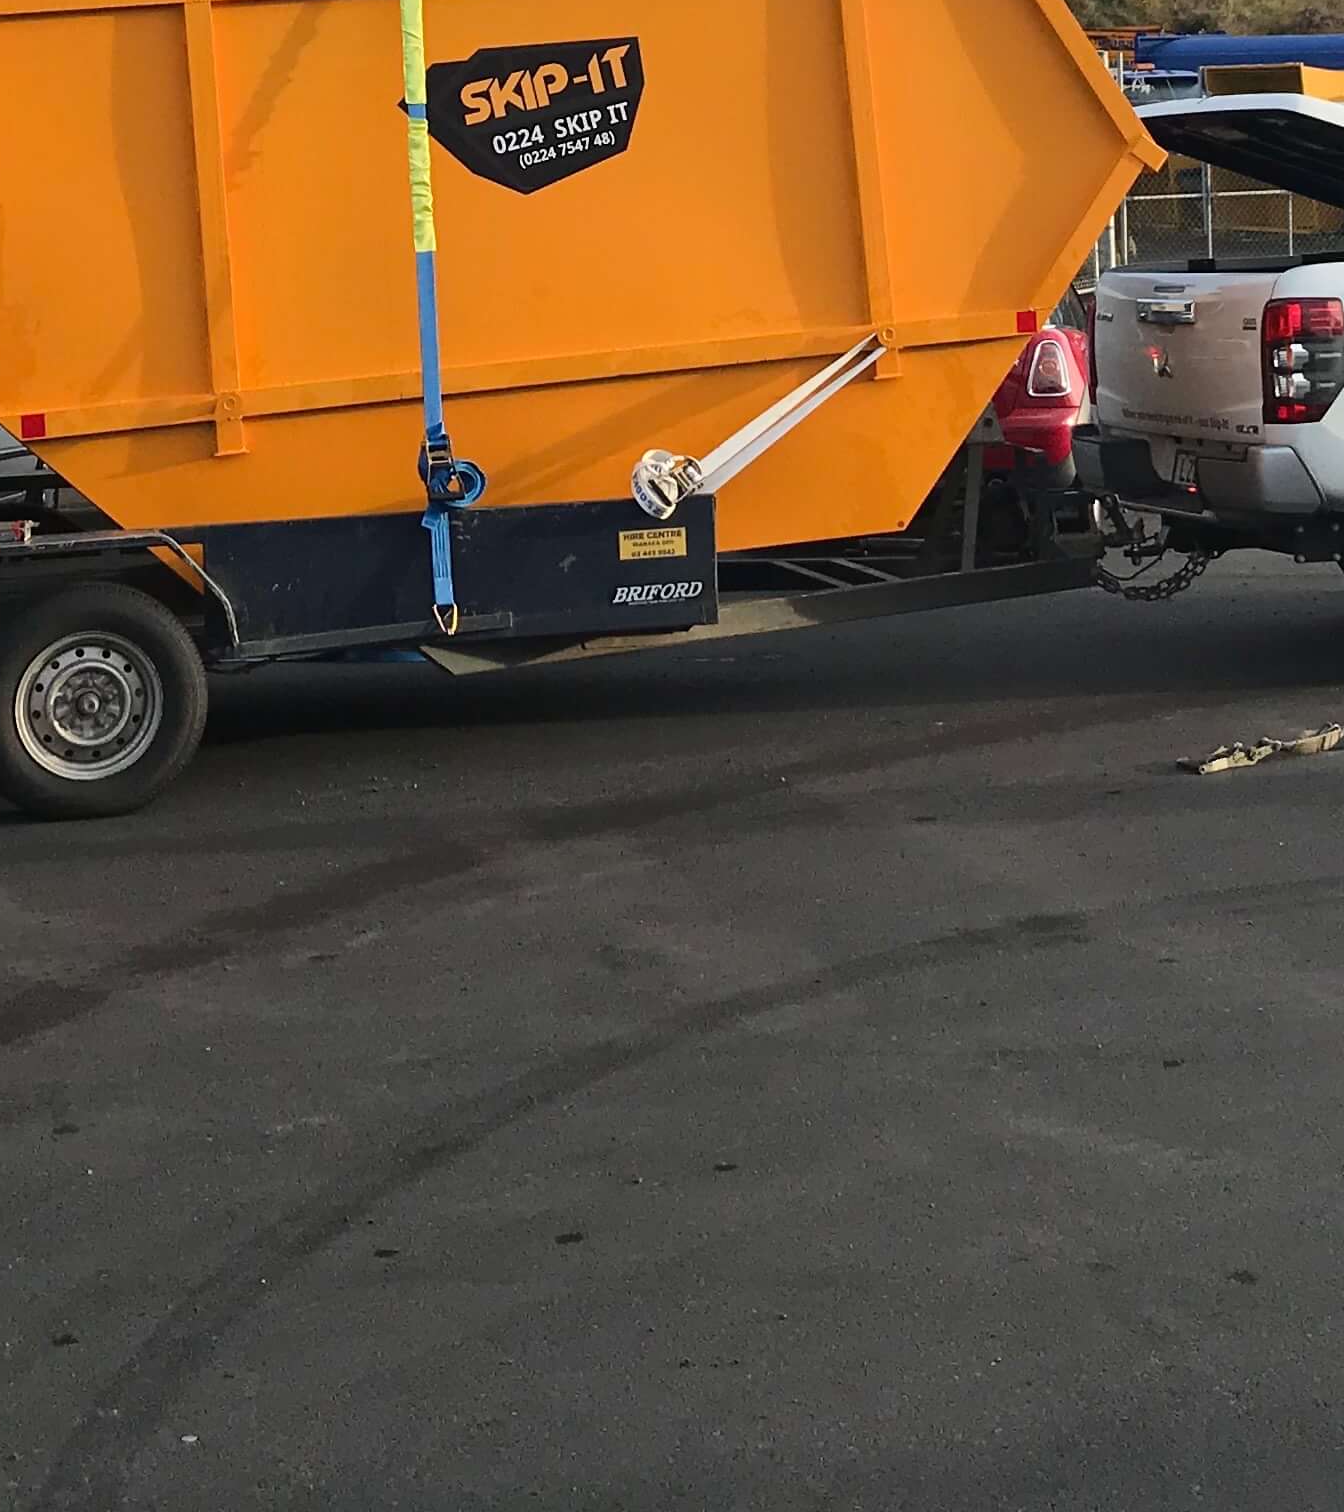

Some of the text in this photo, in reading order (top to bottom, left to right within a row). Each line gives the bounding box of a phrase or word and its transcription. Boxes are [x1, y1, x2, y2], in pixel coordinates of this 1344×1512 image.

[460, 44, 631, 125] SKIP-IT
[492, 102, 628, 154] 0224 SKIP IT
[519, 130, 616, 169] (0224 7547 48)
[646, 529, 682, 539] CENTRE
[612, 581, 703, 604] BRIFORD
